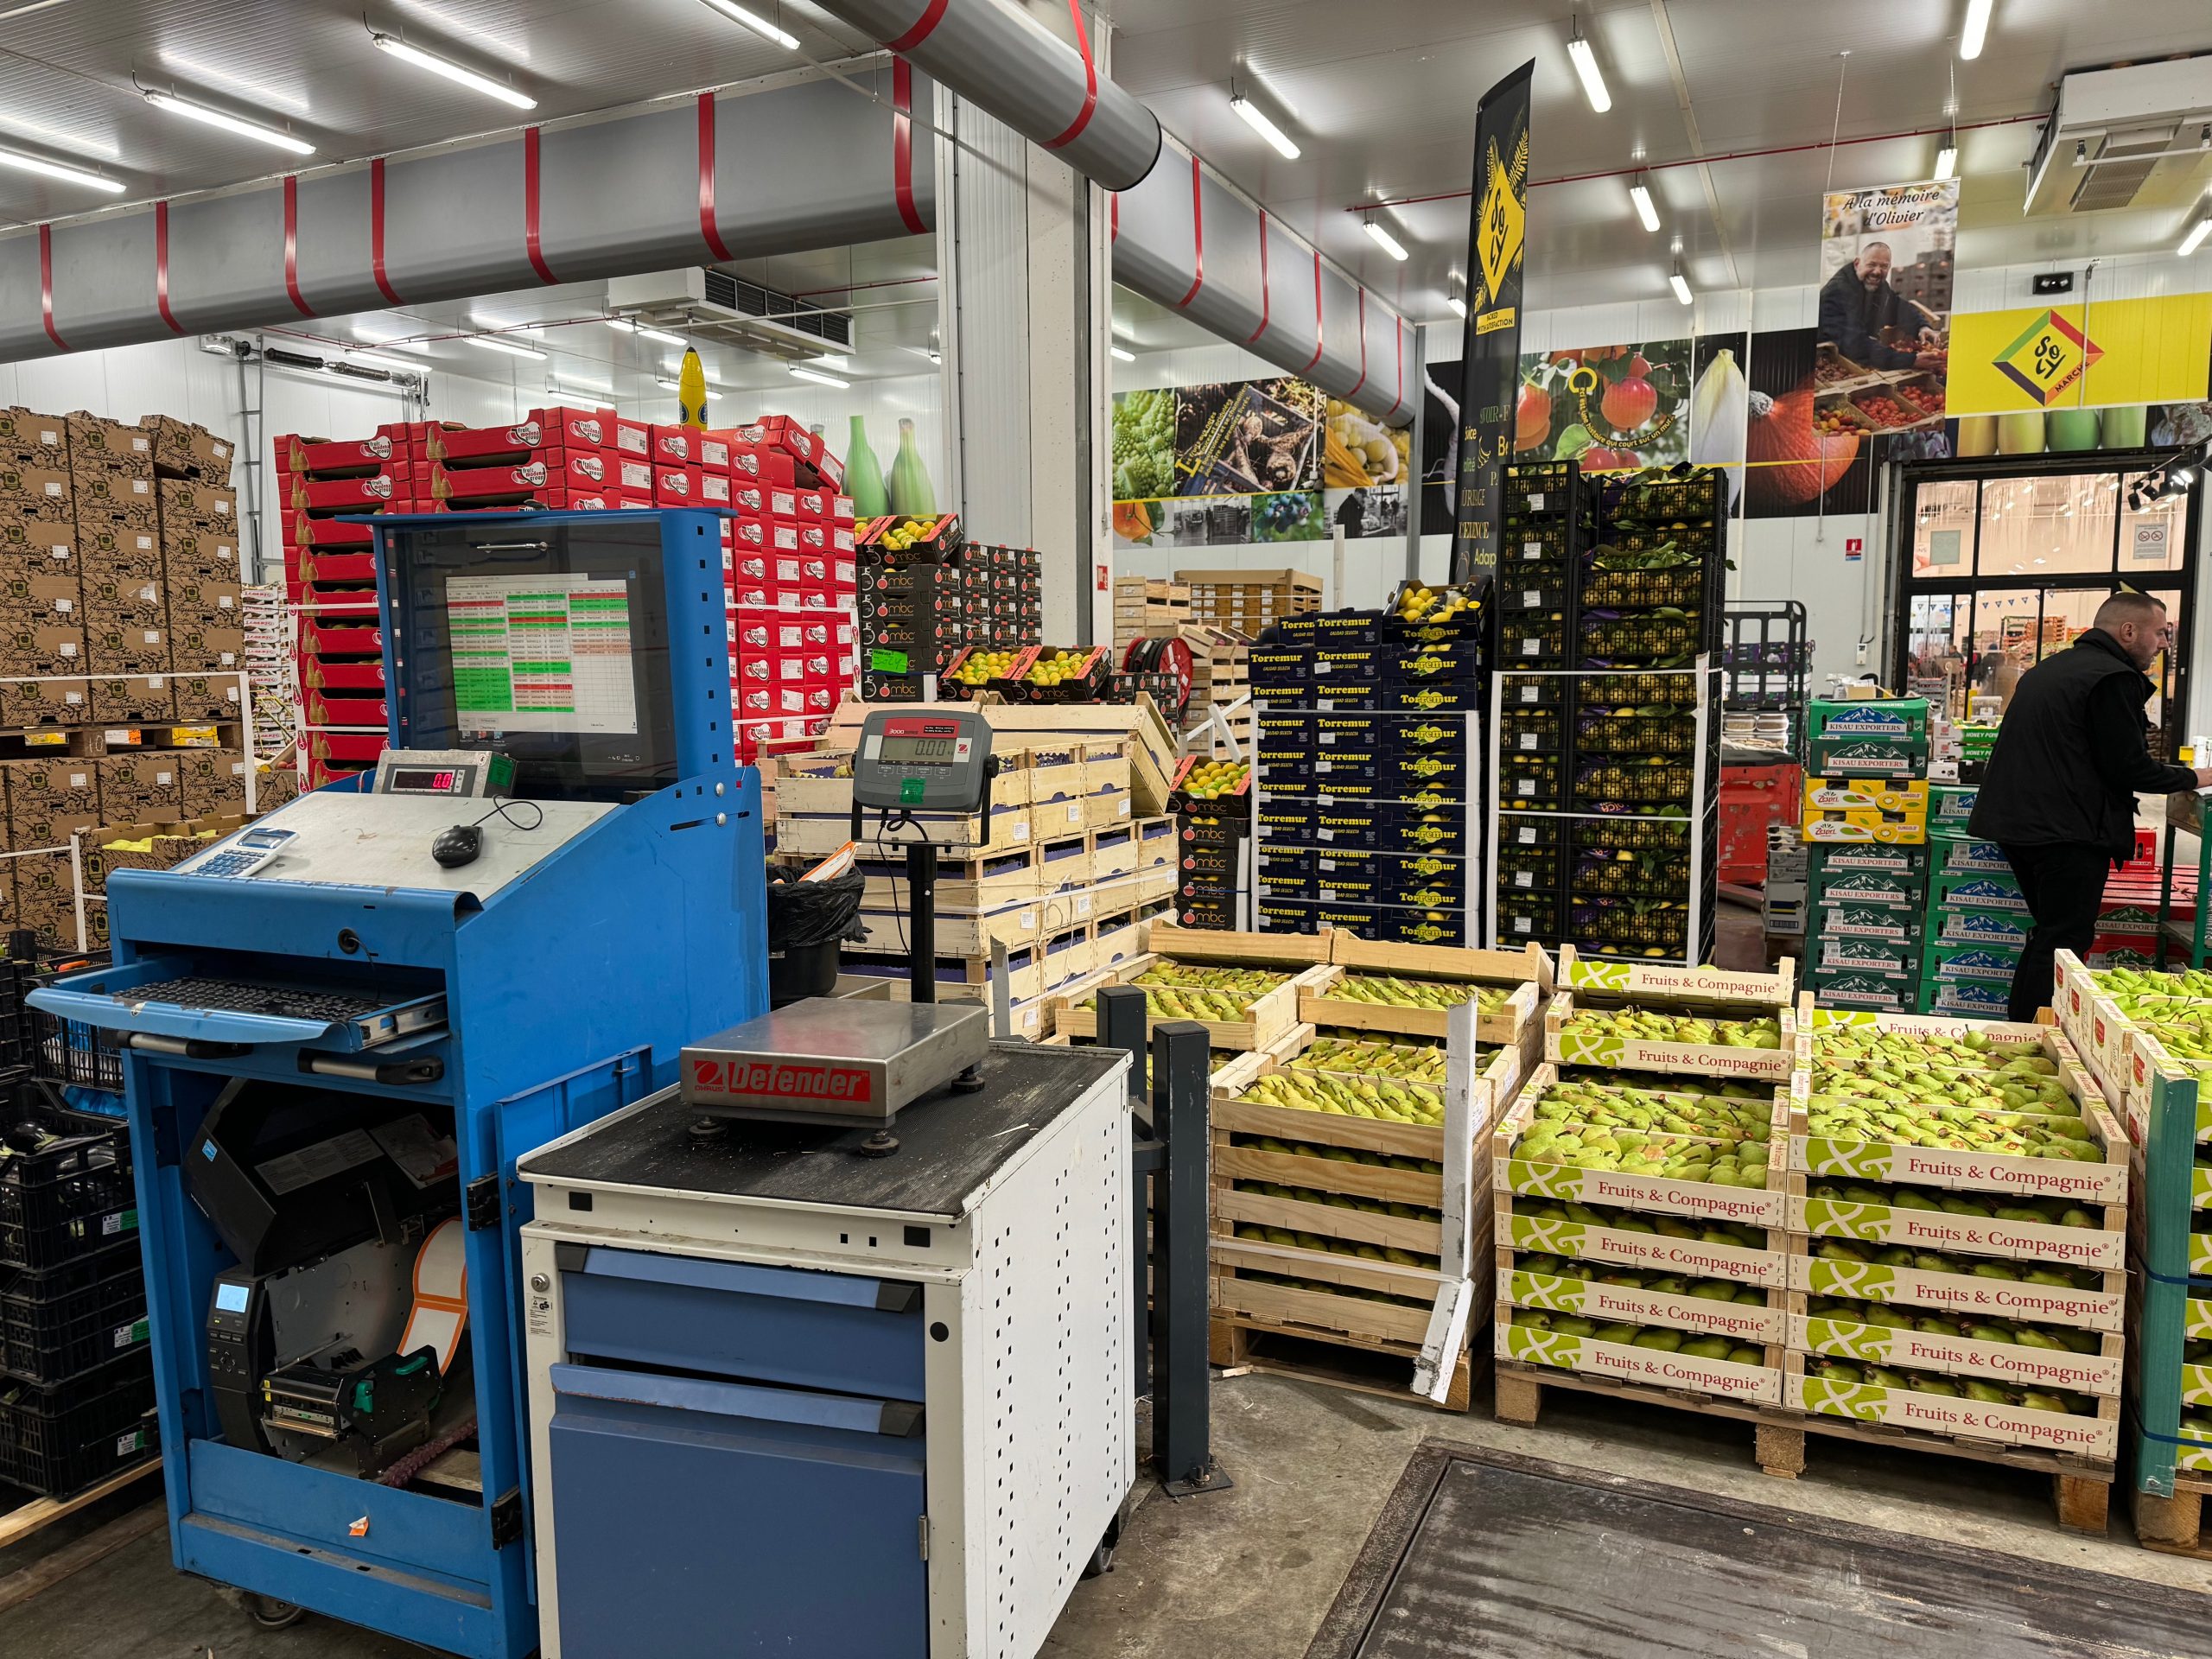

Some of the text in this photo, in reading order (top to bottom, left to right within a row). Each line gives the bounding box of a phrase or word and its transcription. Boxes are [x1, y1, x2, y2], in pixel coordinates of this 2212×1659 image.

[1843, 190, 1940, 210] A la mémoire
[1864, 211, 1924, 226] d'Olivier
[1223, 414, 1243, 441] premiers
[1586, 423, 1605, 443] histoire
[1651, 430, 1661, 439] un
[1189, 441, 1203, 458] fruits
[1205, 411, 1218, 429] notes
[888, 575, 913, 586] mbc
[888, 602, 914, 613] mbc
[1317, 618, 1371, 627] Torremur
[1403, 627, 1460, 638] Torremur
[1251, 654, 1302, 663] Torremur
[1317, 652, 1371, 661] Torremur
[1400, 660, 1457, 670] Torremur
[891, 683, 915, 694] mbc
[1401, 695, 1458, 704] Torremur
[915, 740, 947, 756] 0.00
[1318, 752, 1371, 761] Torremur
[433, 773, 452, 788] 0.0
[1198, 802, 1227, 812] mbc
[1319, 816, 1371, 826] Torremur
[1196, 829, 1225, 840] mbc
[1196, 858, 1226, 868] mbc
[1401, 860, 1456, 871] Torremur
[1975, 898, 2024, 907] EXPORTERS
[1319, 912, 1371, 922] Torremur
[1854, 926, 1898, 935] EXPORTERS
[1973, 932, 2020, 942] EXPORTERS
[1971, 968, 2014, 978] EXPORTER
[1642, 973, 1679, 987] Fruits
[1683, 977, 1696, 988] &
[1847, 993, 1892, 1001] EXPORTERS
[1934, 1026, 1947, 1036] &
[1638, 1050, 1678, 1064] Fruits
[1682, 1054, 1694, 1065] &
[1909, 1158, 1961, 1177] Fruits
[1967, 1165, 1984, 1179] &
[1598, 1181, 1644, 1199] Fruits
[1649, 1189, 1663, 1203] &
[1907, 1221, 1961, 1240] Fruits
[1967, 1230, 1982, 1243] &
[1600, 1237, 1646, 1256] Fruits
[1651, 1246, 1665, 1260] &
[1916, 1284, 1968, 1302] Fruits
[1974, 1290, 1991, 1304] &
[1599, 1294, 1644, 1314] Fruits
[1649, 1304, 1663, 1318] &
[1910, 1342, 1962, 1363] Fruits
[1968, 1352, 1984, 1365] &
[1594, 1351, 1640, 1371] Fruits
[1644, 1361, 1658, 1374] &
[1905, 1402, 1957, 1423] Fruits
[1963, 1412, 1979, 1427] &
